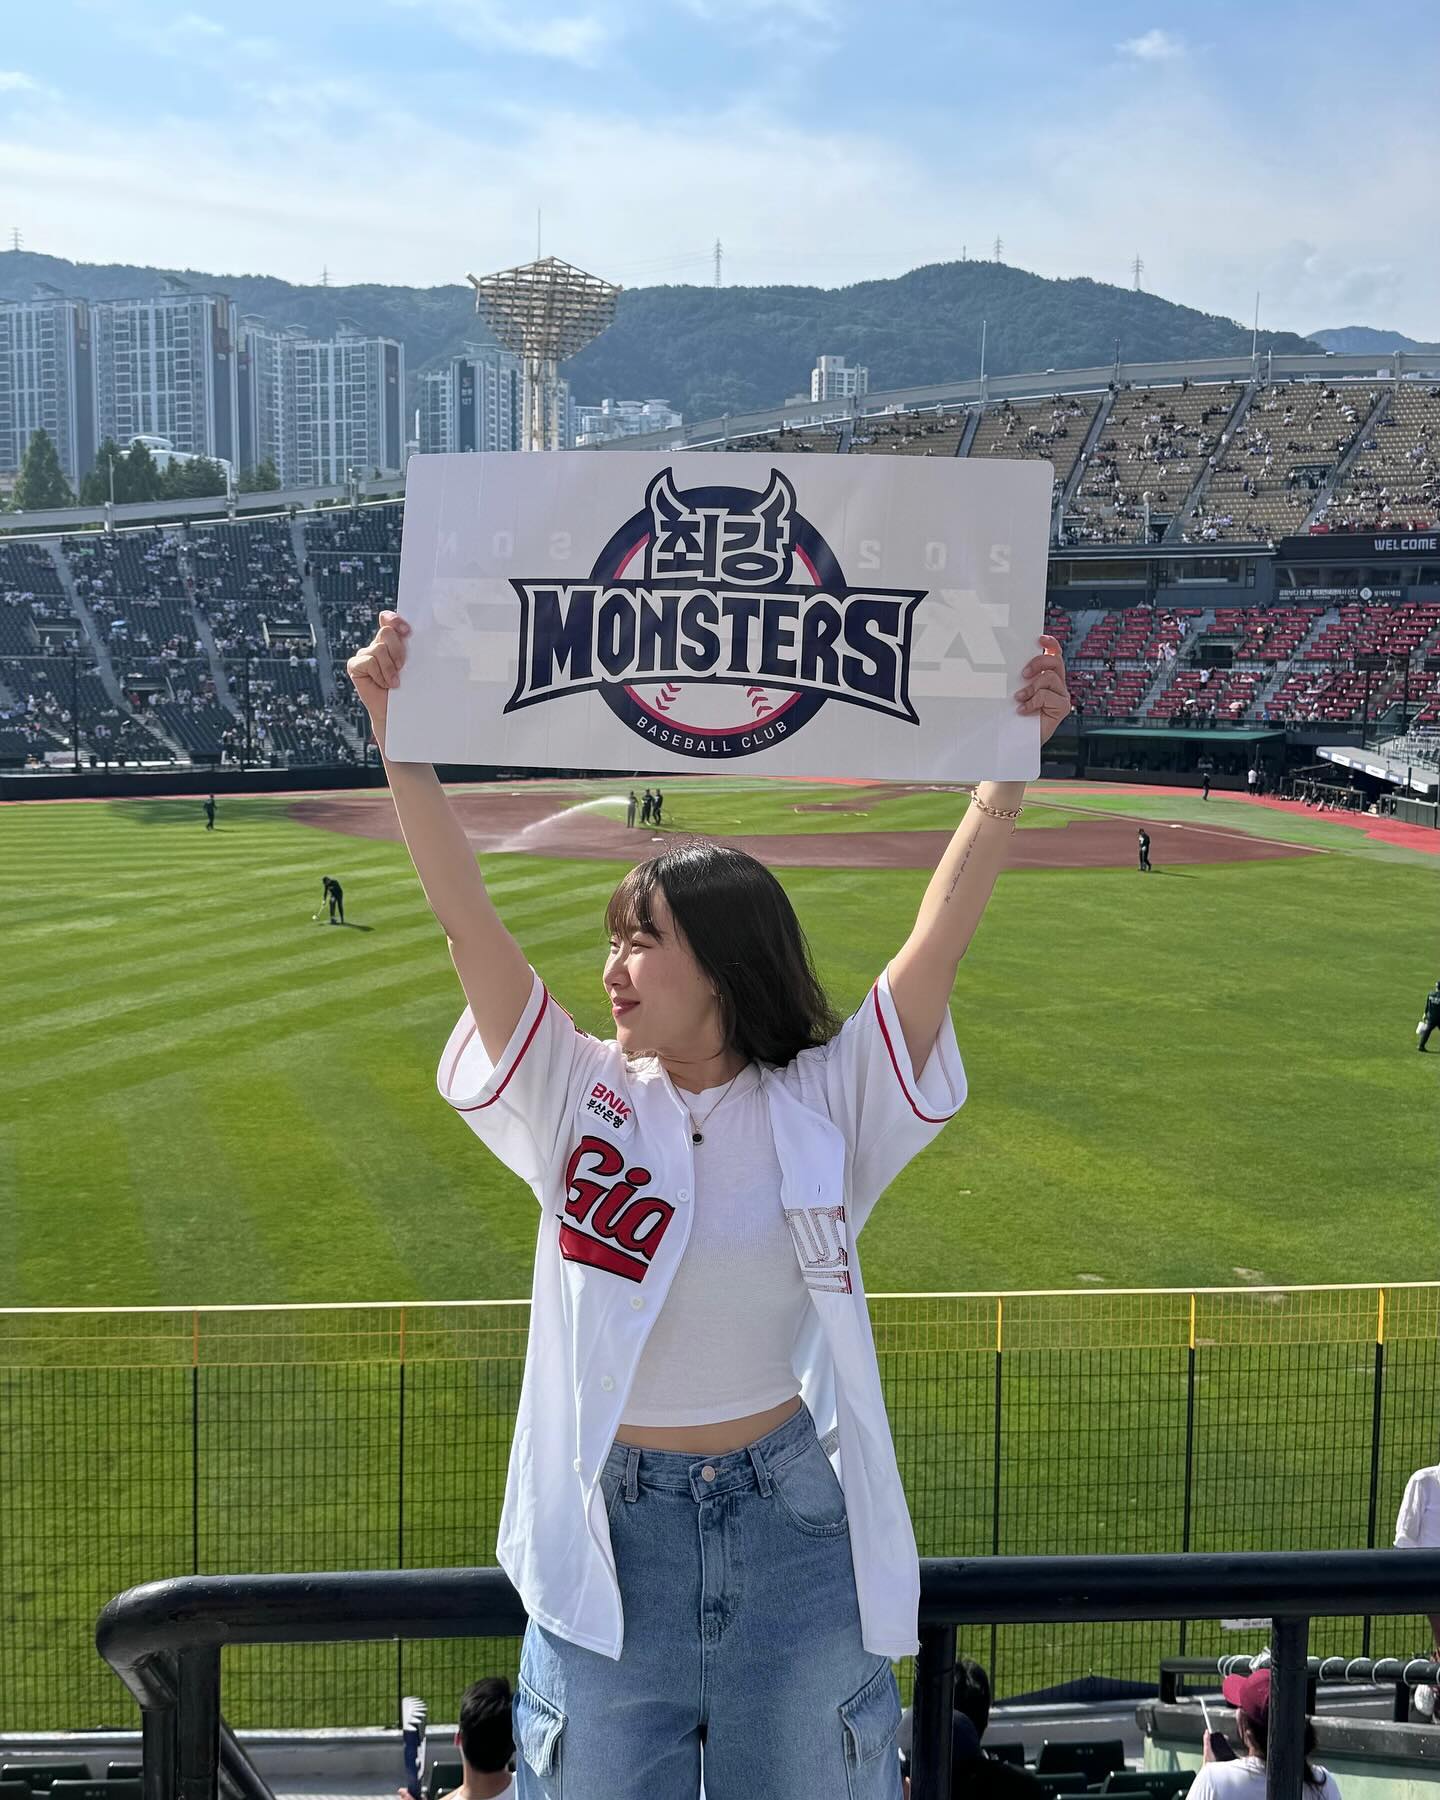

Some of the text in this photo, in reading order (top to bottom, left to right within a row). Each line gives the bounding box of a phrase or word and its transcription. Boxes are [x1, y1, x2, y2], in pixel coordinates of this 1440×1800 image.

[652, 495, 786, 585] 최강
[1374, 538, 1437, 551] WELCOME
[526, 586, 905, 706] MONSTERS
[636, 716, 787, 752] BASEBALL CLUB
[586, 1098, 625, 1129] 부산은행
[591, 1082, 632, 1121] BNK
